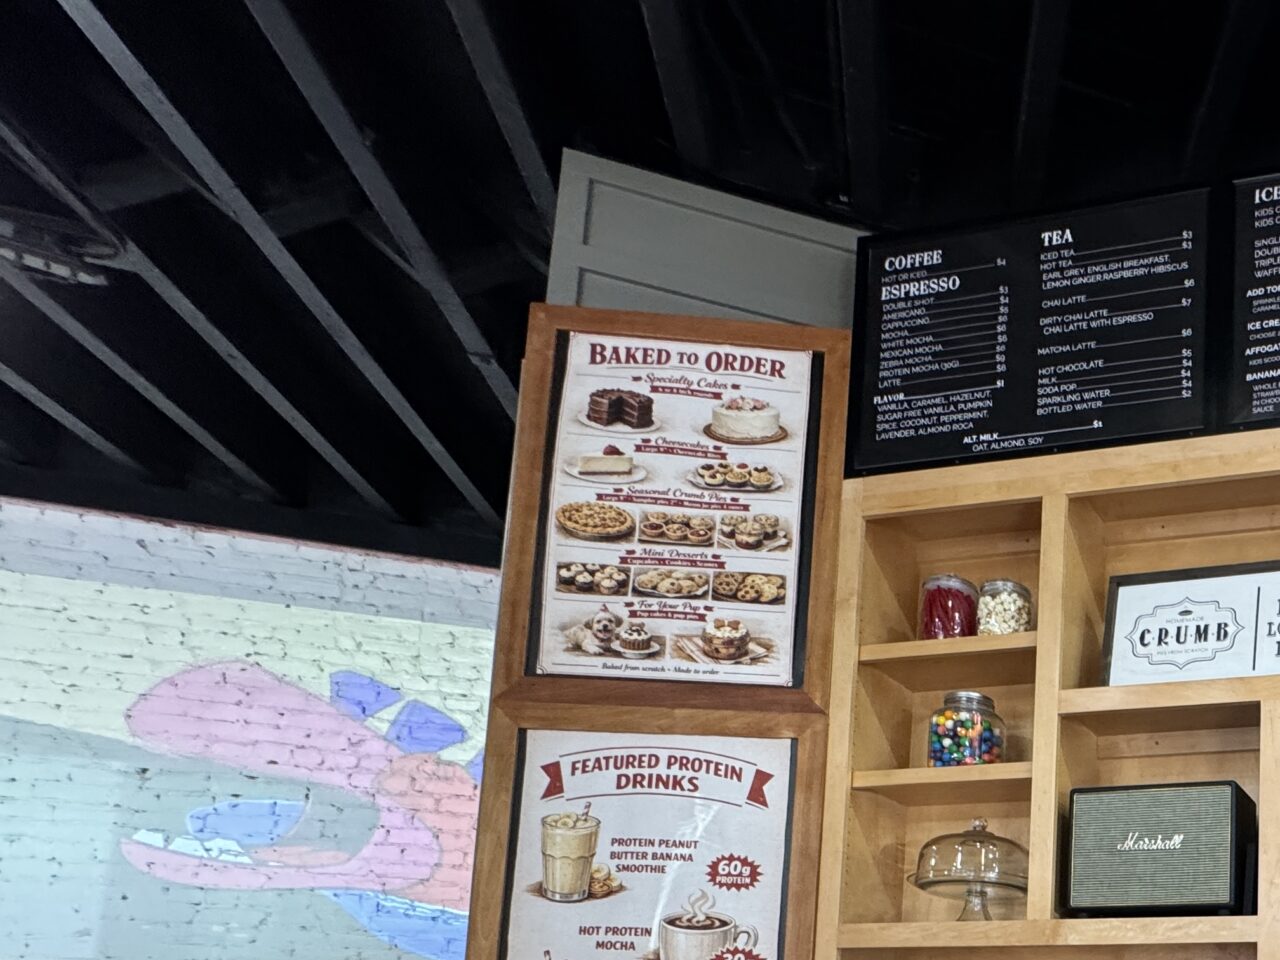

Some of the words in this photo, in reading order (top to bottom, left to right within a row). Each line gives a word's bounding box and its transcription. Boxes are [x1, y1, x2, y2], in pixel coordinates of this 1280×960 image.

[1254, 209, 1274, 218] KIDS
[1254, 219, 1274, 229] KIDS
[1041, 228, 1074, 246] TEA
[884, 249, 943, 271] COFFEE
[1040, 252, 1058, 261] ICED
[1060, 249, 1075, 258] TEA
[1040, 263, 1057, 271] HOT
[1058, 260, 1074, 269] TEA
[881, 275, 960, 300] ESPRESSO
[1246, 289, 1265, 298] ADD
[1062, 295, 1088, 305] LATTE
[1247, 321, 1262, 331] ICE
[705, 351, 786, 379] ORDER
[1038, 366, 1056, 376] HOT
[643, 373, 694, 388] Specialty
[697, 378, 729, 391] Cakes
[873, 393, 905, 405] FLAVOR
[655, 436, 710, 451] Cheesecakes
[627, 486, 670, 497] Seasonal
[672, 487, 705, 501] Crumb
[708, 492, 728, 503] Pies
[640, 547, 664, 557] Mini
[668, 550, 709, 561] Desserts
[638, 599, 654, 609] For
[657, 600, 679, 612] Your
[682, 602, 702, 613] Pup
[570, 753, 661, 777] FEATURED
[666, 754, 744, 783] PROTEIN
[615, 772, 700, 793] DRINKS
[610, 837, 656, 849] PROTEIN
[657, 839, 700, 850] PEANUT
[1117, 832, 1185, 851] Marshall
[609, 851, 650, 862] BUTTER
[651, 852, 695, 863] BANANA
[615, 863, 668, 875] SMOOTHIE
[717, 860, 752, 877] 60g
[715, 876, 751, 885] PROTEIN
[578, 926, 602, 937] HOT
[604, 926, 653, 938] PROTEIN
[595, 940, 637, 952] MOCHA
